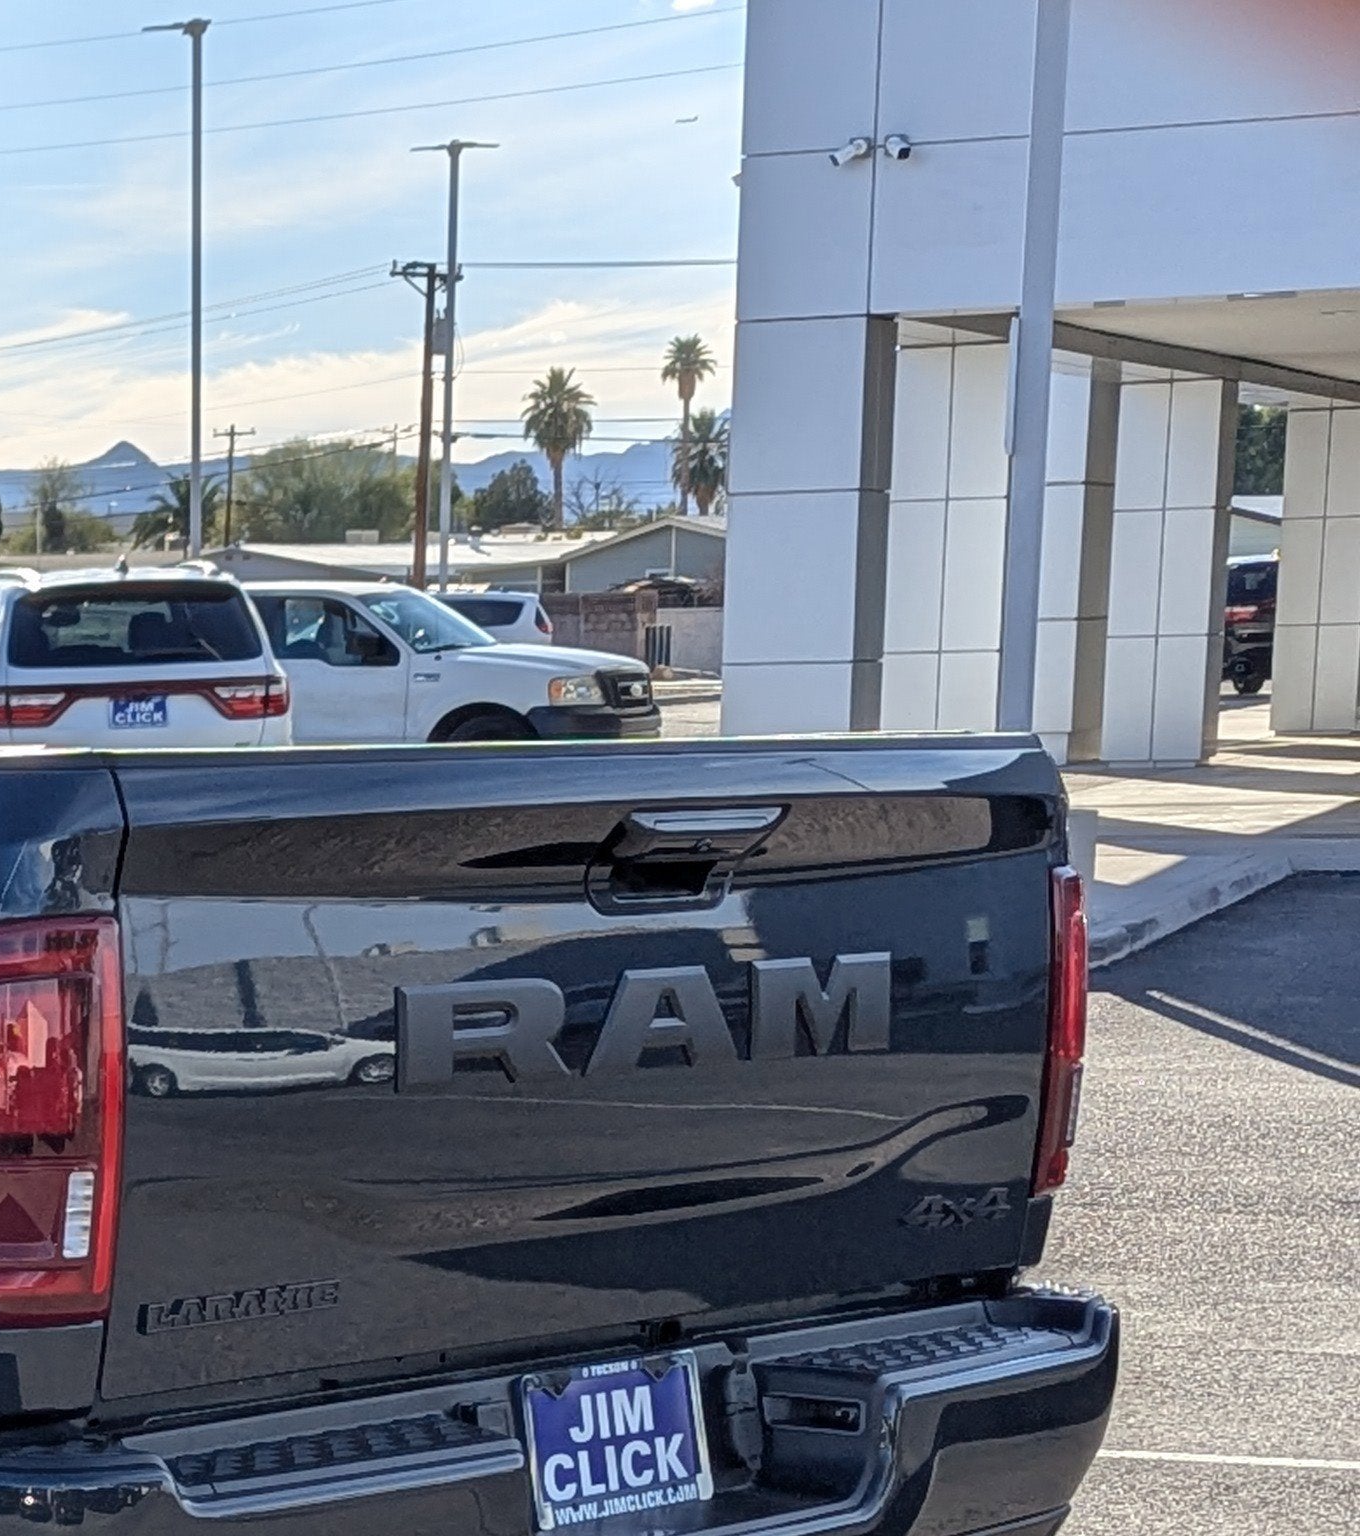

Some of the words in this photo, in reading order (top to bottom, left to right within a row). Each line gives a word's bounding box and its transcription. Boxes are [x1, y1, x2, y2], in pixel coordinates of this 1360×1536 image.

[115, 711, 163, 724] CLICK
[394, 951, 891, 1094] RAM
[136, 1278, 341, 1336] LARAMIE
[568, 1385, 655, 1444] JIM
[543, 1433, 689, 1502] CLICK
